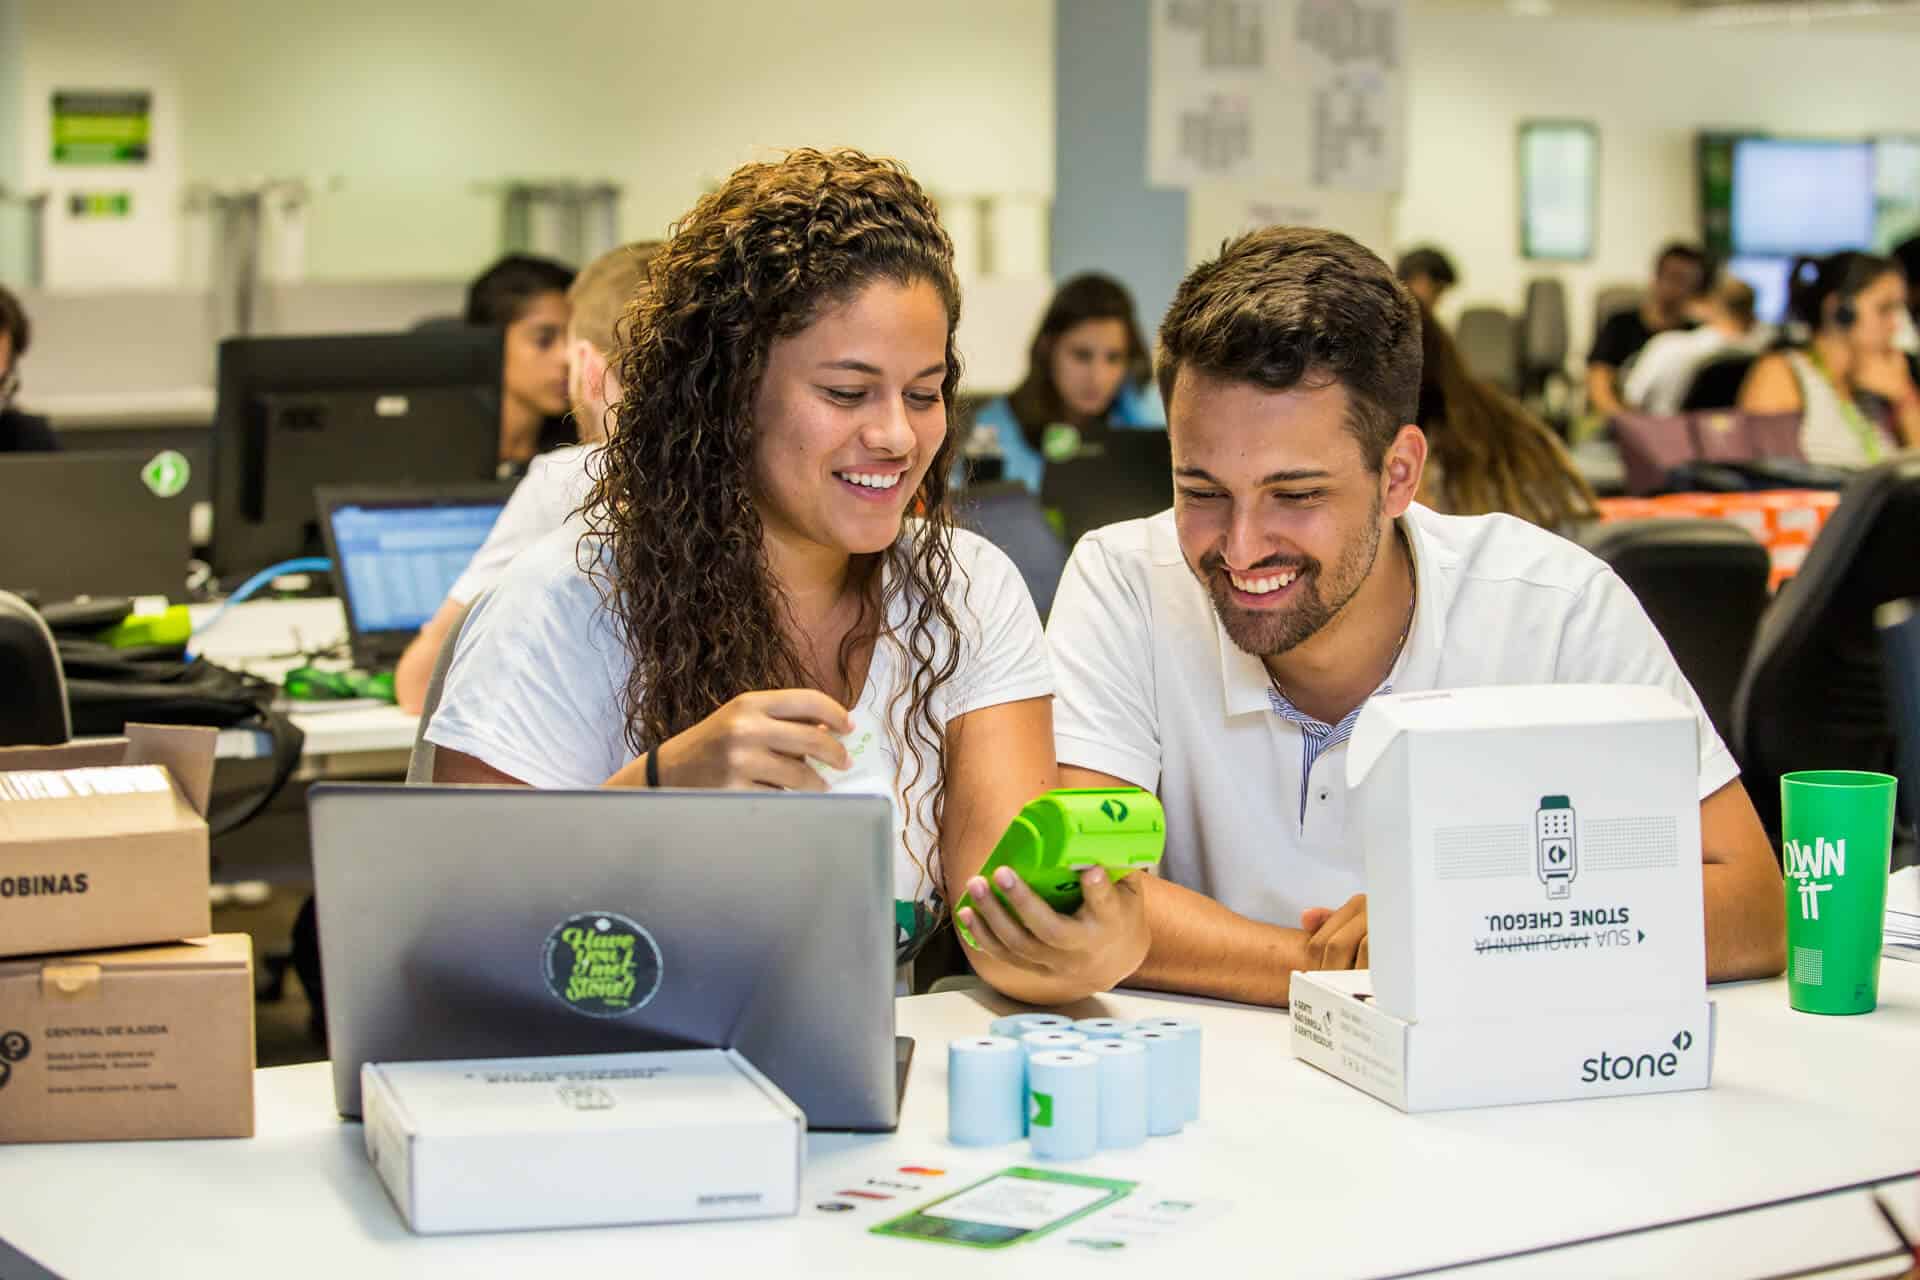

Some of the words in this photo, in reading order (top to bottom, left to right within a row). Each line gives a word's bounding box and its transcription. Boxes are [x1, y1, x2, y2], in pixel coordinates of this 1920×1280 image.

[1784, 837, 1846, 879] OWN
[1485, 912, 1563, 931] CHEGOU.
[1570, 907, 1629, 926] STONE
[1474, 932, 1592, 954] MAQUININHA
[1595, 929, 1631, 947] SUA
[1581, 1051, 1678, 1082] stone
